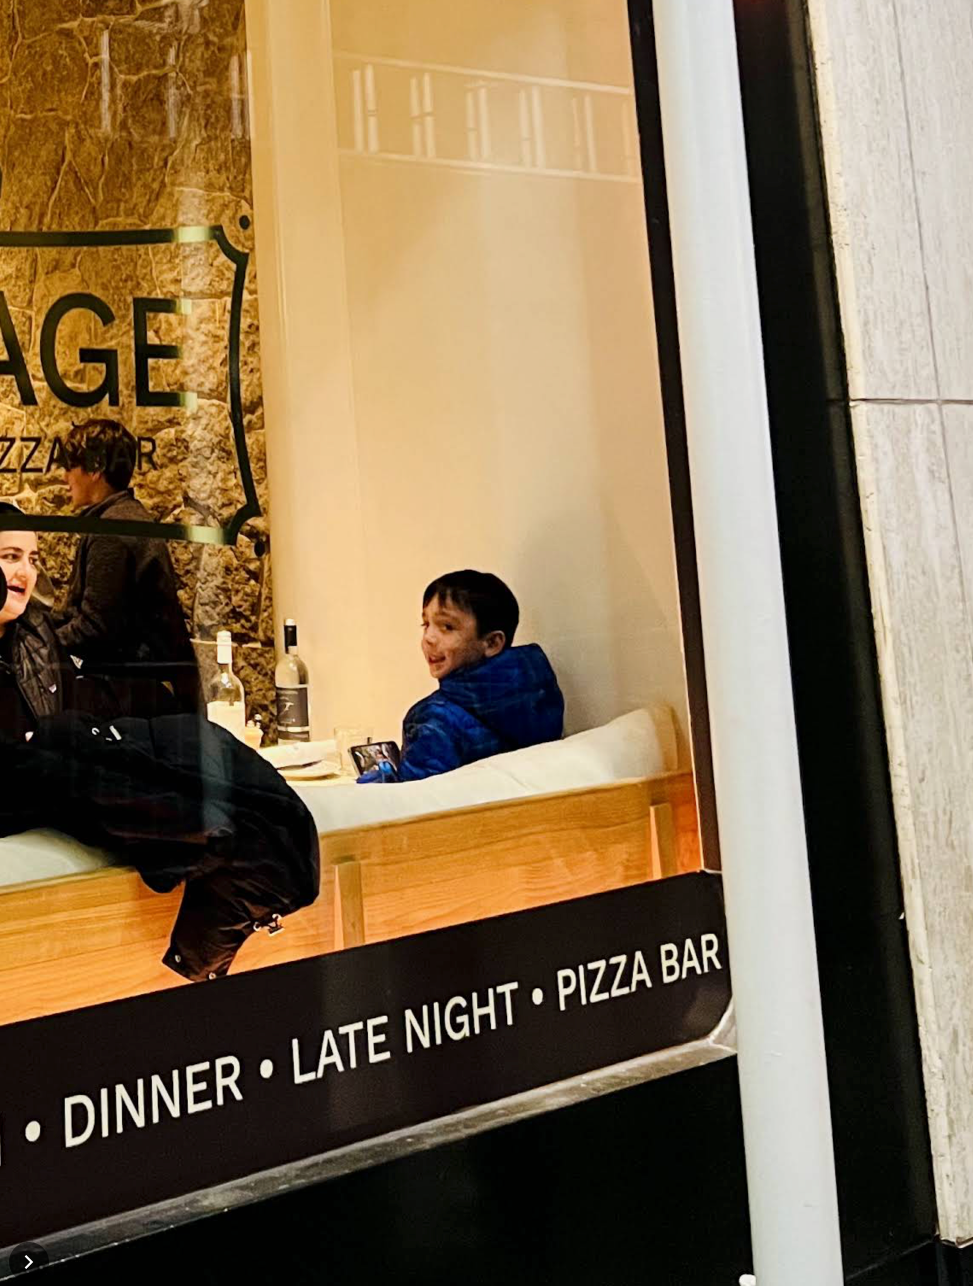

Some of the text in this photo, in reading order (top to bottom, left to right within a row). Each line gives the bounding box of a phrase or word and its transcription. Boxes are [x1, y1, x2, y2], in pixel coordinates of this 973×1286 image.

[64, 1055, 243, 1148] DINNER
[291, 1016, 392, 1085] LATE
[404, 982, 519, 1053] NIGHT
[557, 950, 653, 1011] PIZZA
[660, 933, 723, 984] BAR
